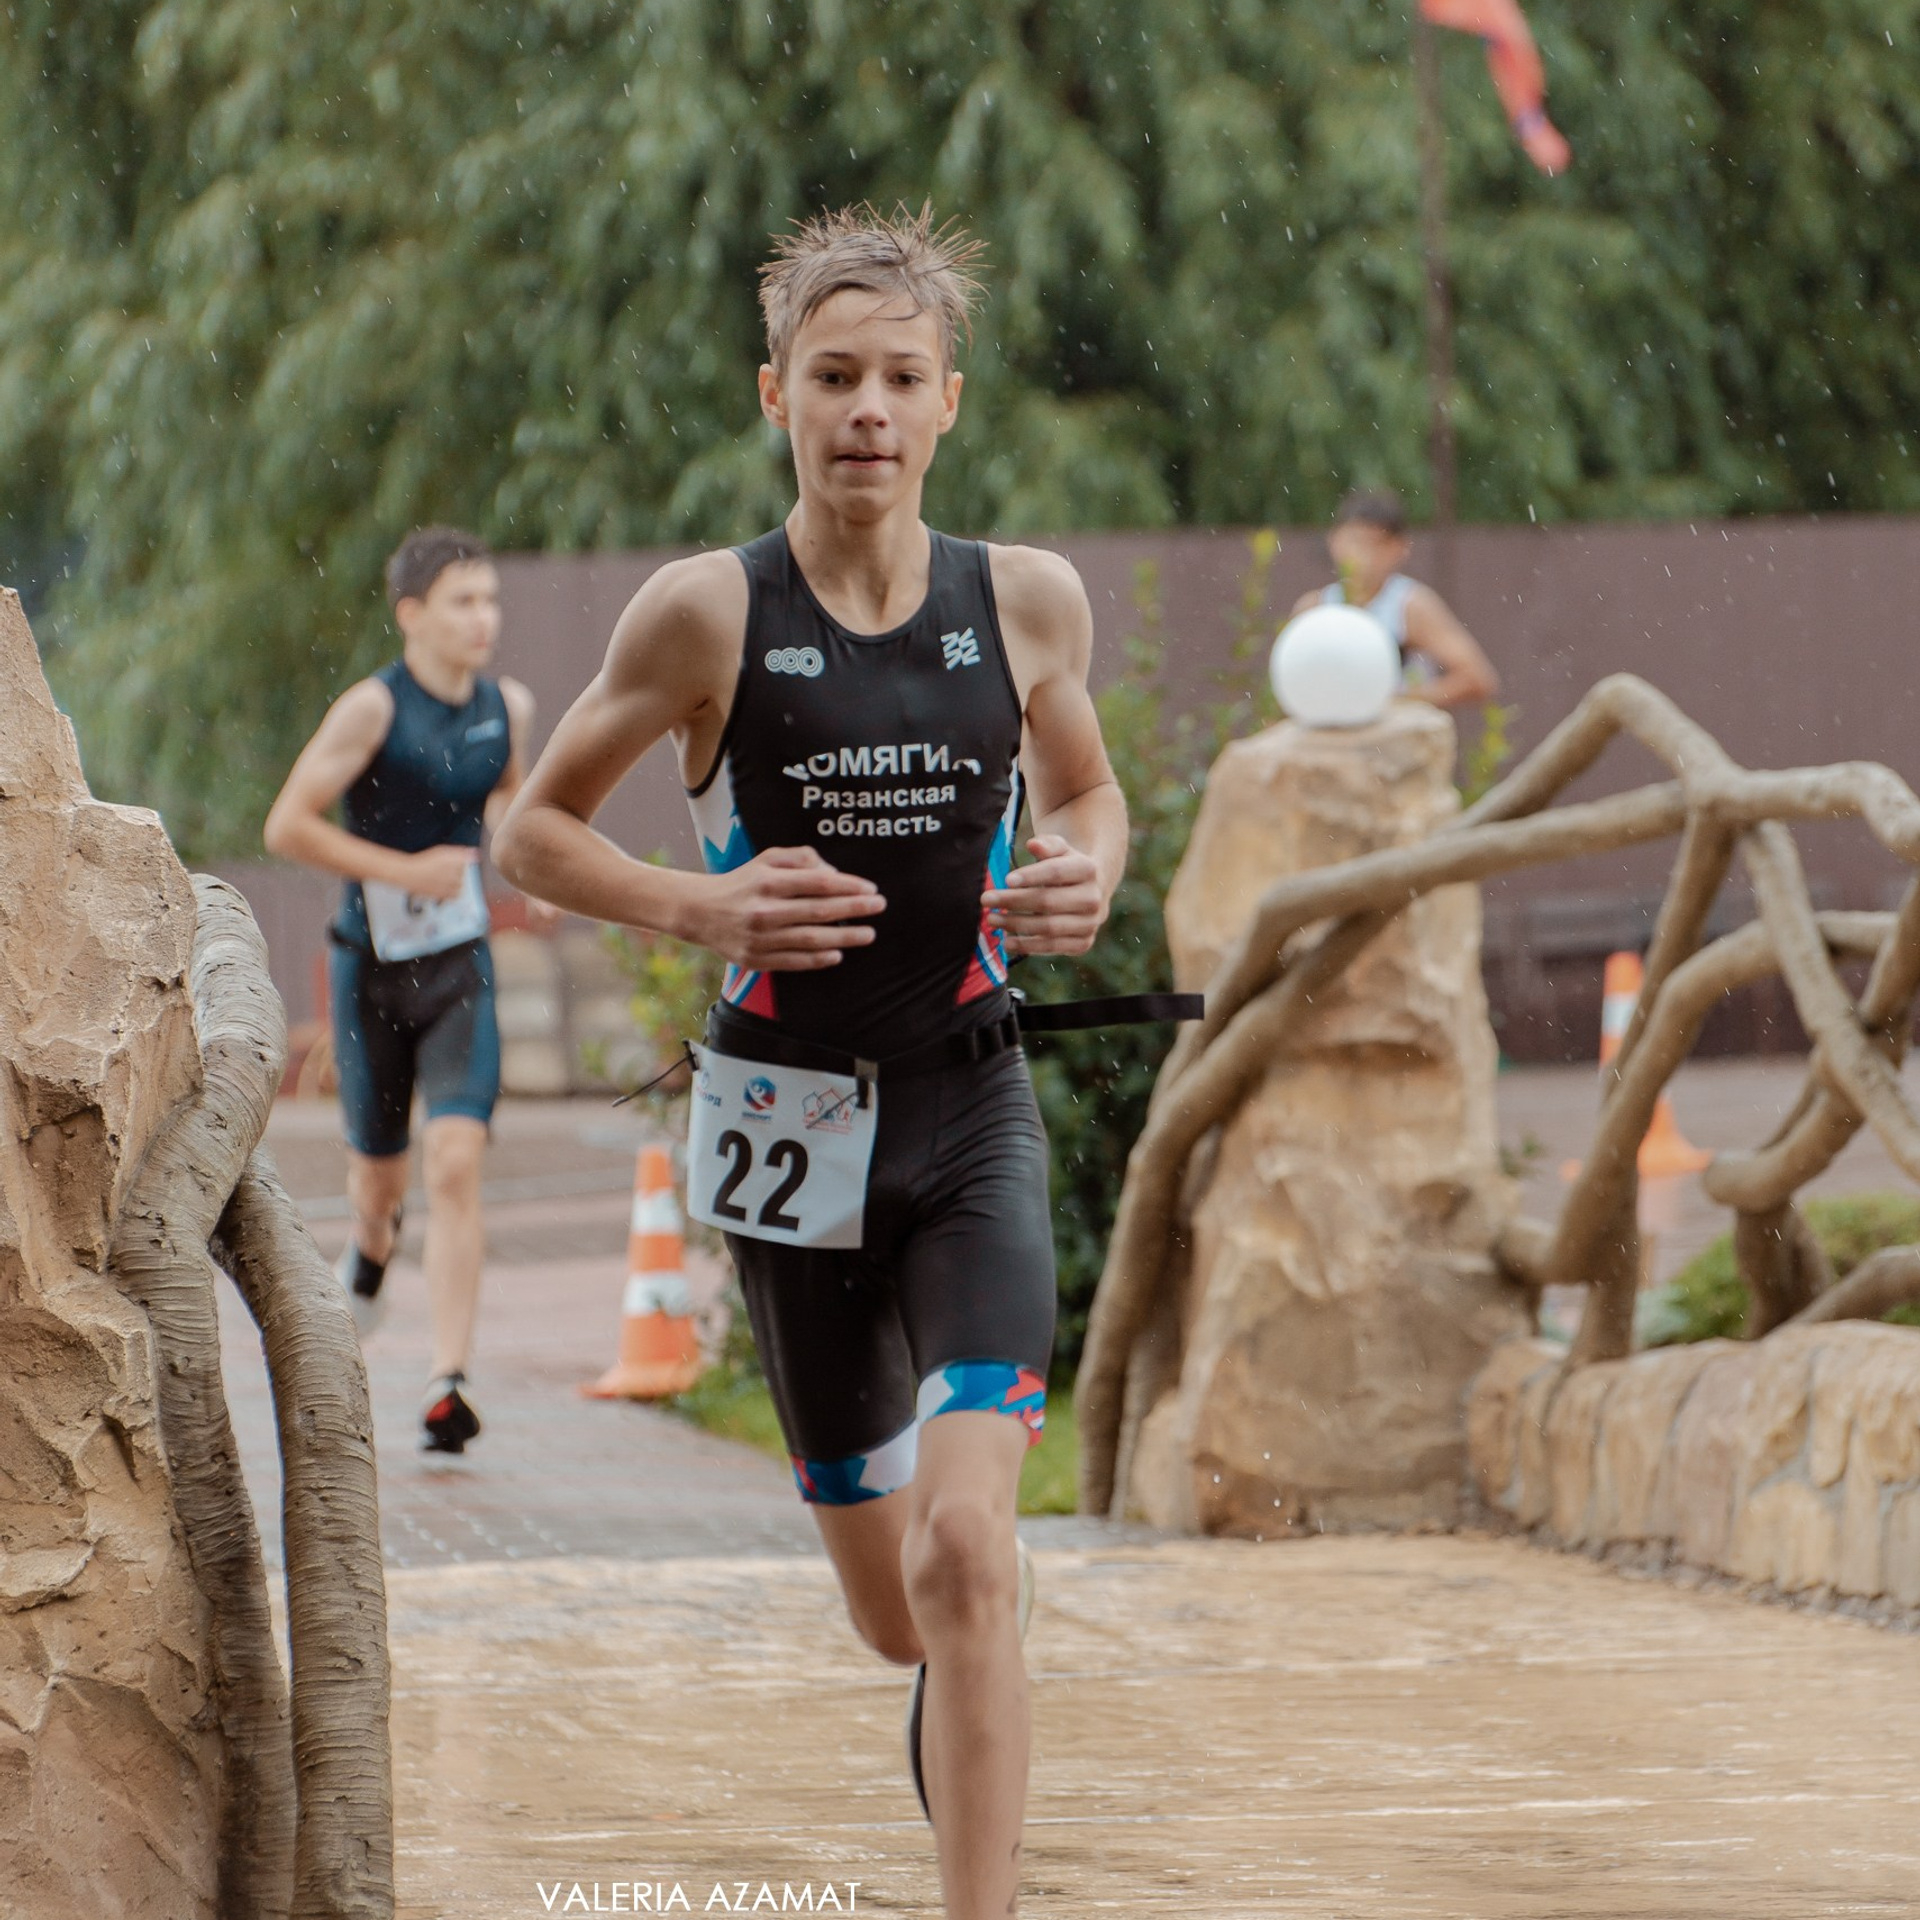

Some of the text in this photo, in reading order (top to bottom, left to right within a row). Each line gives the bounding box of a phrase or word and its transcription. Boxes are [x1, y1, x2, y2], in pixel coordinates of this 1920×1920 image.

[802, 784, 956, 809] Рязанская
[816, 813, 942, 837] область
[711, 1129, 809, 1232] 22
